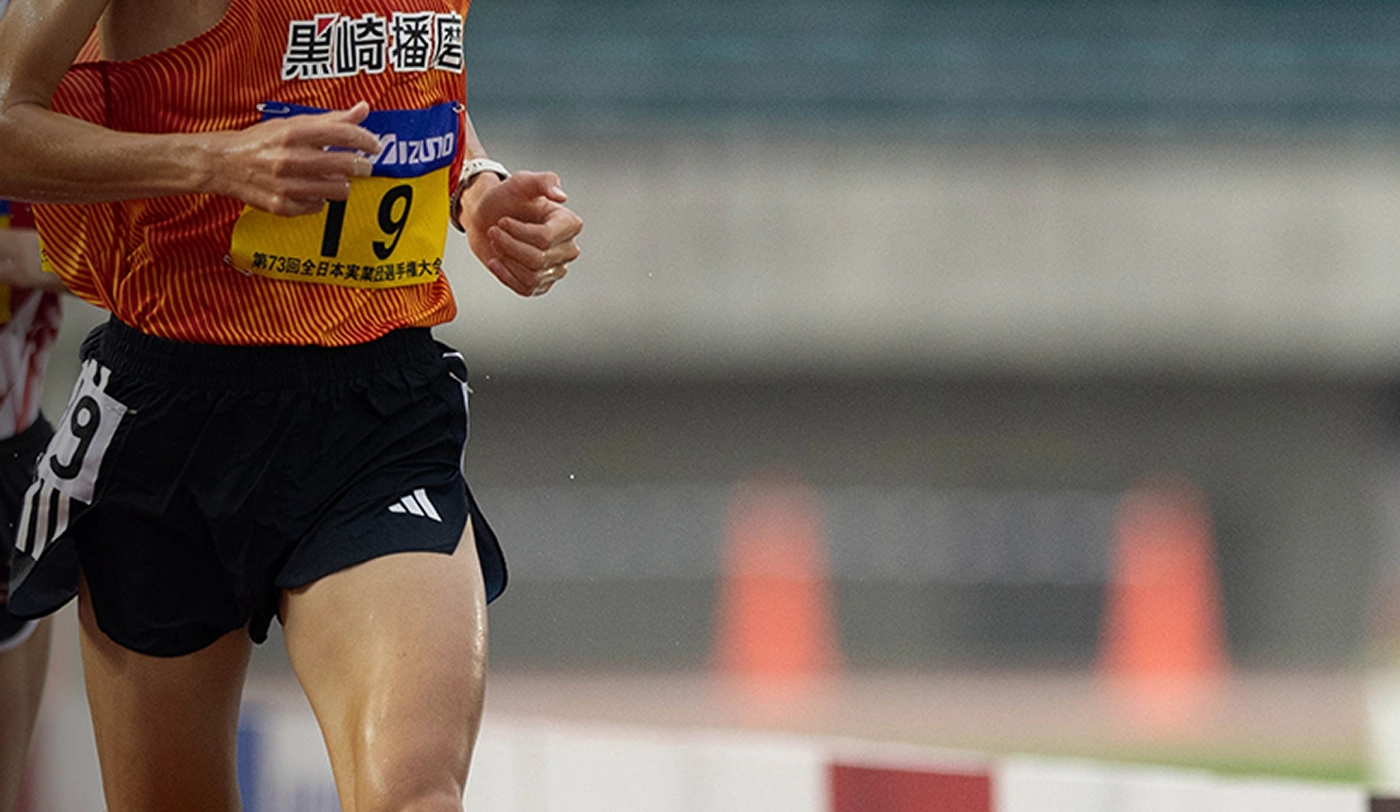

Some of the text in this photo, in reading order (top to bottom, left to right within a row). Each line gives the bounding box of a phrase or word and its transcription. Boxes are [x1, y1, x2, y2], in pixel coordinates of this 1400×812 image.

[284, 13, 463, 78] 黒崎播磨
[321, 184, 414, 261] 19
[49, 395, 101, 480] 9
